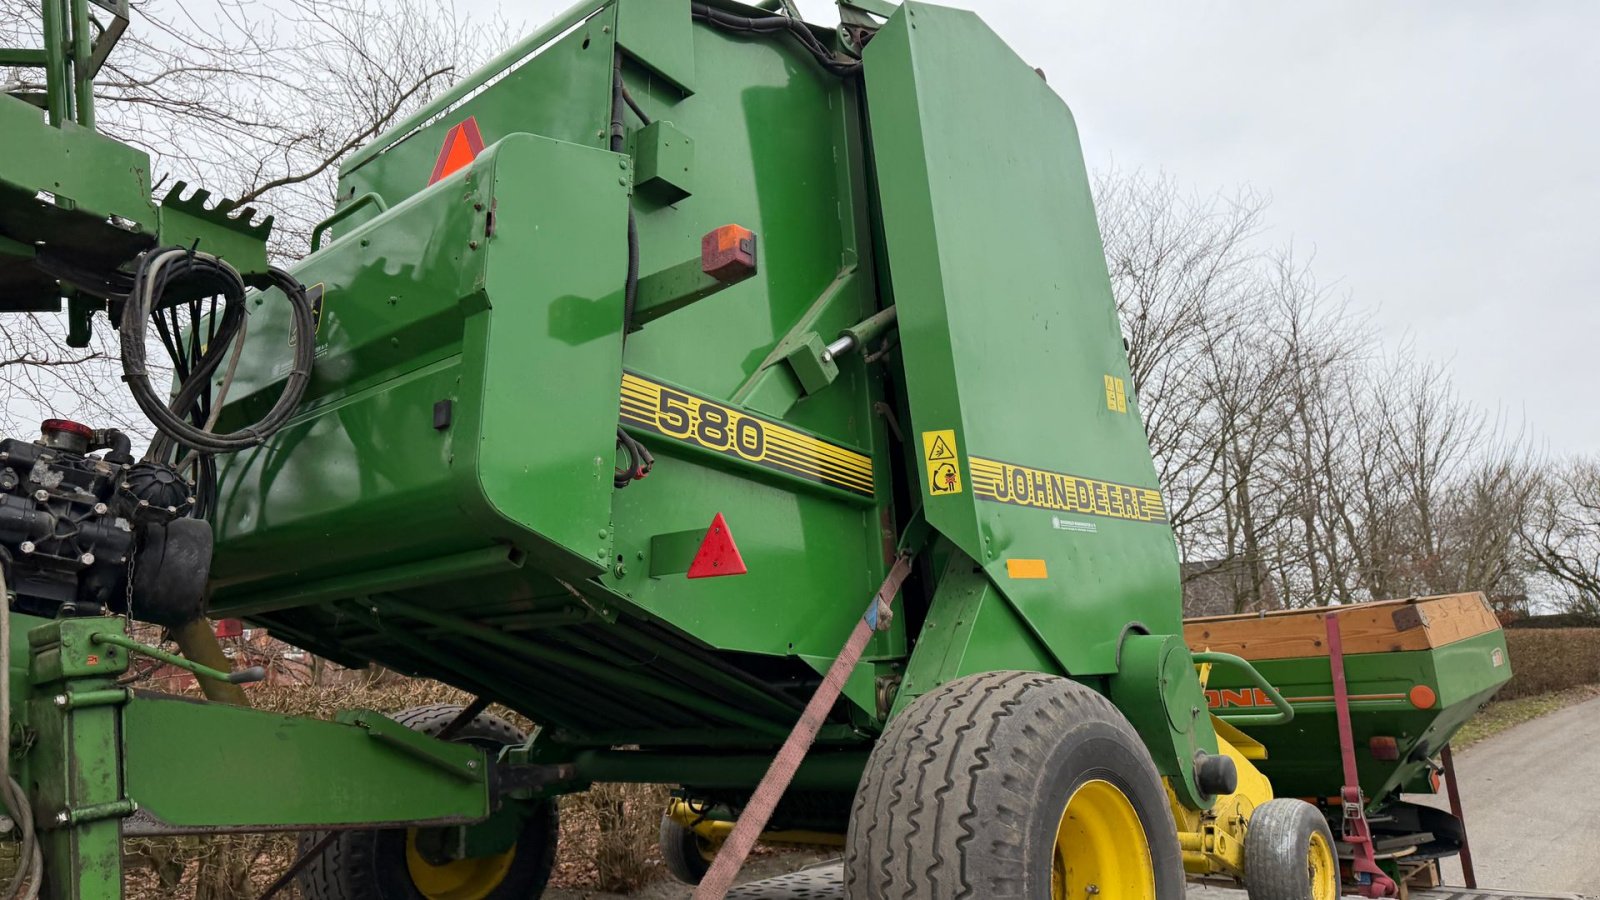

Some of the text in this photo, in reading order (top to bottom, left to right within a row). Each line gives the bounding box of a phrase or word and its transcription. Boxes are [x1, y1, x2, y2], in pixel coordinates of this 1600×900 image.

[656, 387, 766, 460] 580
[994, 464, 1150, 519] JOHN DEERE
